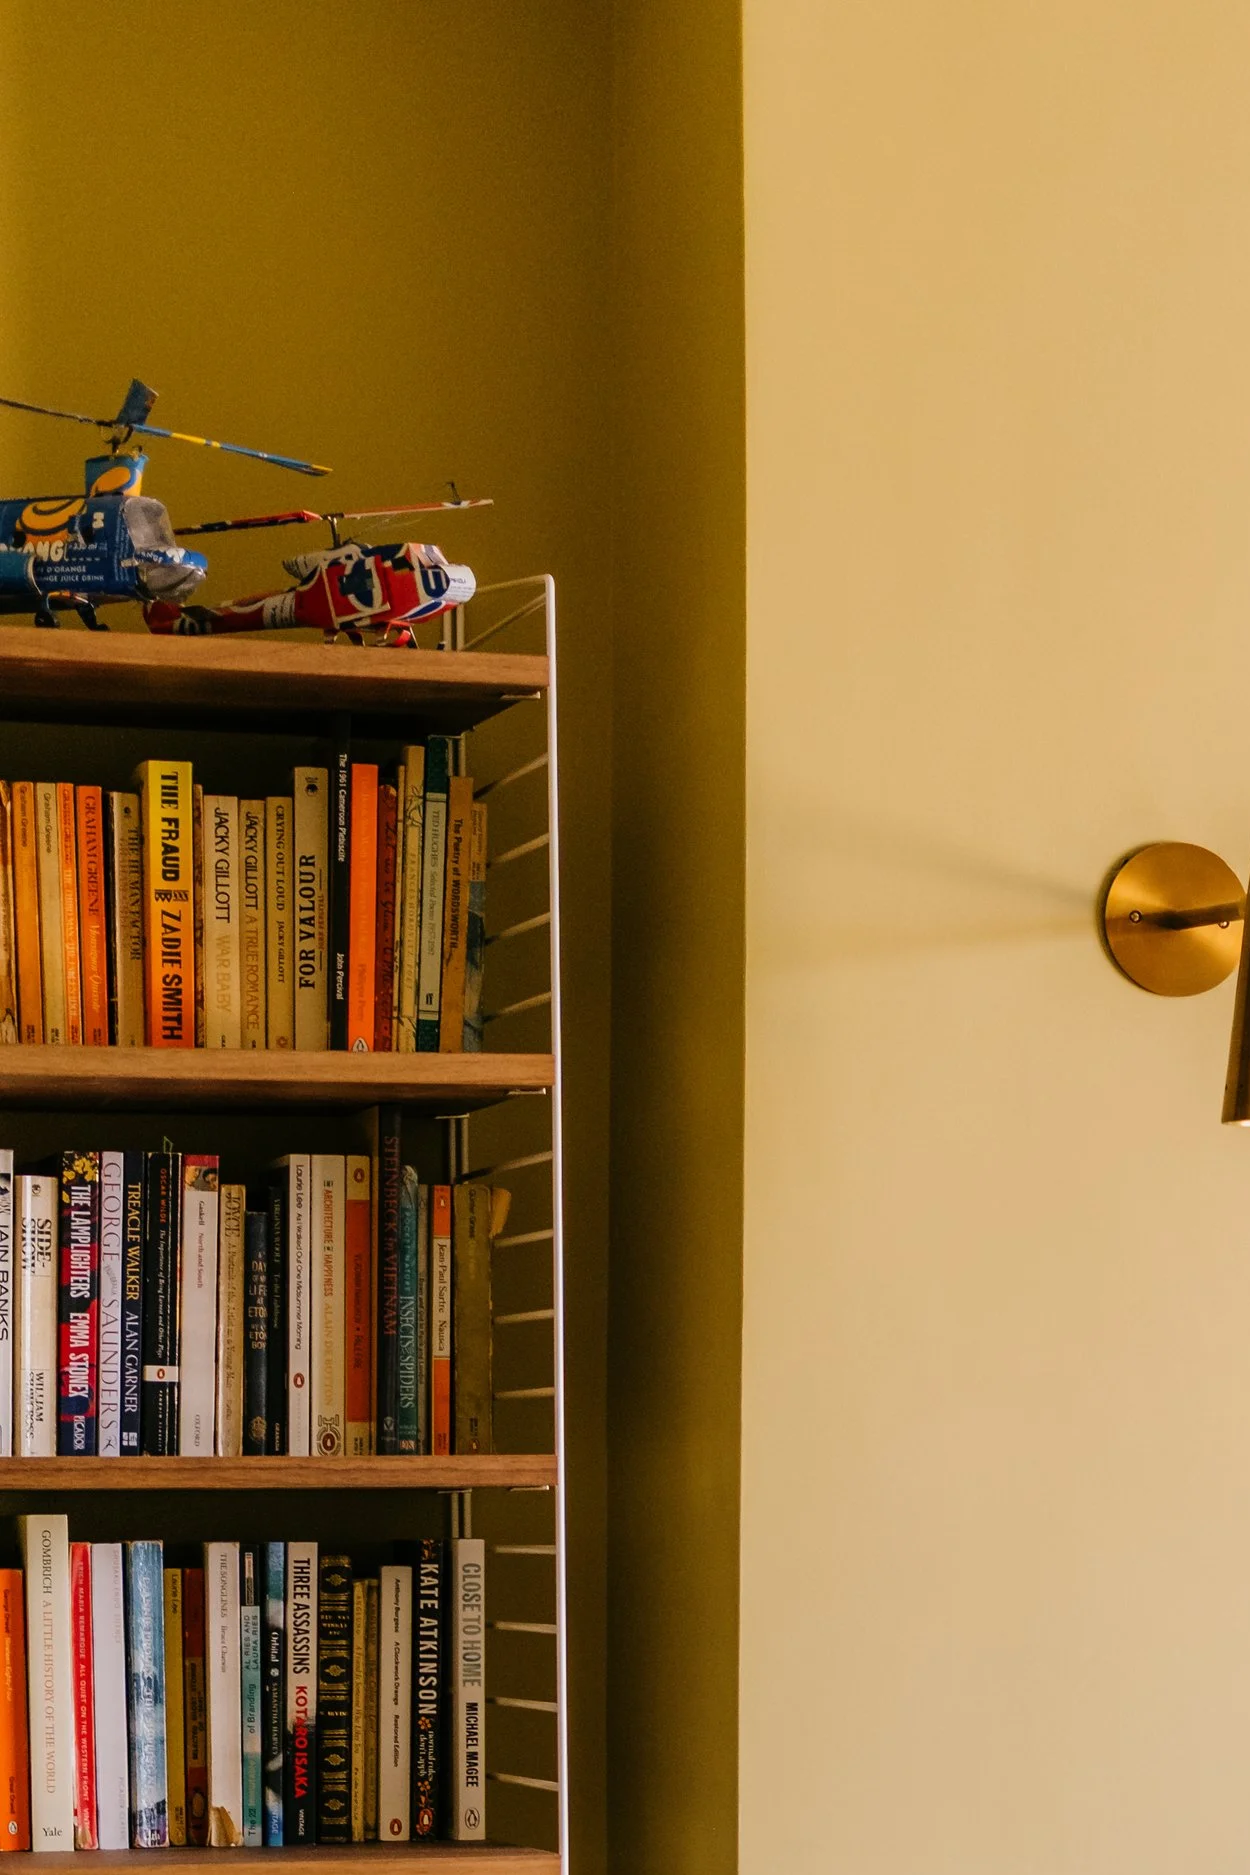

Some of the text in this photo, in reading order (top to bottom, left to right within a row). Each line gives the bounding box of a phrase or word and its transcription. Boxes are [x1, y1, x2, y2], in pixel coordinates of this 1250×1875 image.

[160, 771, 180, 882] THE FRAUD
[337, 753, 347, 862] The 1961 Cameroon Plebiscite
[430, 810, 441, 868] TED HUGHES
[85, 796, 99, 916] GRAHAM GREENE
[128, 828, 141, 960] THE HUMAN FACTOR
[214, 807, 230, 923] JACKY GILLOTT
[245, 811, 258, 910] JACKY GILLOTT
[276, 805, 285, 911] CRYING OUT LOUD
[246, 915, 258, 925] A
[246, 928, 258, 962] TRUE
[277, 921, 285, 946] JACKY
[299, 855, 316, 990] FOR VALOUR
[161, 909, 183, 1040] ZADIE SMITH
[216, 934, 231, 1012] WAR BABY
[246, 965, 259, 1030] ROMANCE
[336, 953, 344, 999] John Percival
[224, 1192, 241, 1237] JOYCE
[295, 1165, 304, 1208] Laurie Lee
[70, 1184, 91, 1298] THE LAMPLIGHTERS
[126, 1183, 141, 1300] TREACLE WALKER
[323, 1189, 334, 1296] ARCHITECTURE HAPPINESS
[383, 1136, 398, 1335] STEINBECK in VIETNAM
[101, 1162, 120, 1429] GEORGE SAUNDERS
[437, 1244, 447, 1313] Jean-Paul Sartre
[67, 1312, 89, 1398] EMMA STONEX
[124, 1311, 138, 1412] ALAN GARNER
[399, 1295, 414, 1408] INSECTS SPIDERS
[35, 1372, 44, 1422] WILLIAM
[42, 1529, 52, 1595] GOMBRICH
[171, 1574, 179, 1614] Laurie Lee
[220, 1552, 228, 1618] THE SONGLINES
[393, 1578, 401, 1605] Anthony
[78, 1615, 86, 1659] REMARQUE
[270, 1631, 279, 1662] Orbital
[293, 1558, 310, 1674] THREE ASSASSINS
[418, 1563, 439, 1715] KATE ATKINSON
[462, 1563, 481, 1687] CLOSE TO HOME
[42, 1600, 56, 1793] A LITTLE HISTORY OF THE WORLD
[79, 1680, 87, 1703] QUIET
[244, 1659, 251, 1670] AL
[80, 1705, 87, 1719] ON
[80, 1720, 88, 1736] THE
[295, 1686, 308, 1798] KOTARO ISAKA
[465, 1702, 479, 1787] MICHAEL MAGEE
[81, 1776, 89, 1801] FRONT
[42, 1828, 63, 1836] Yale
